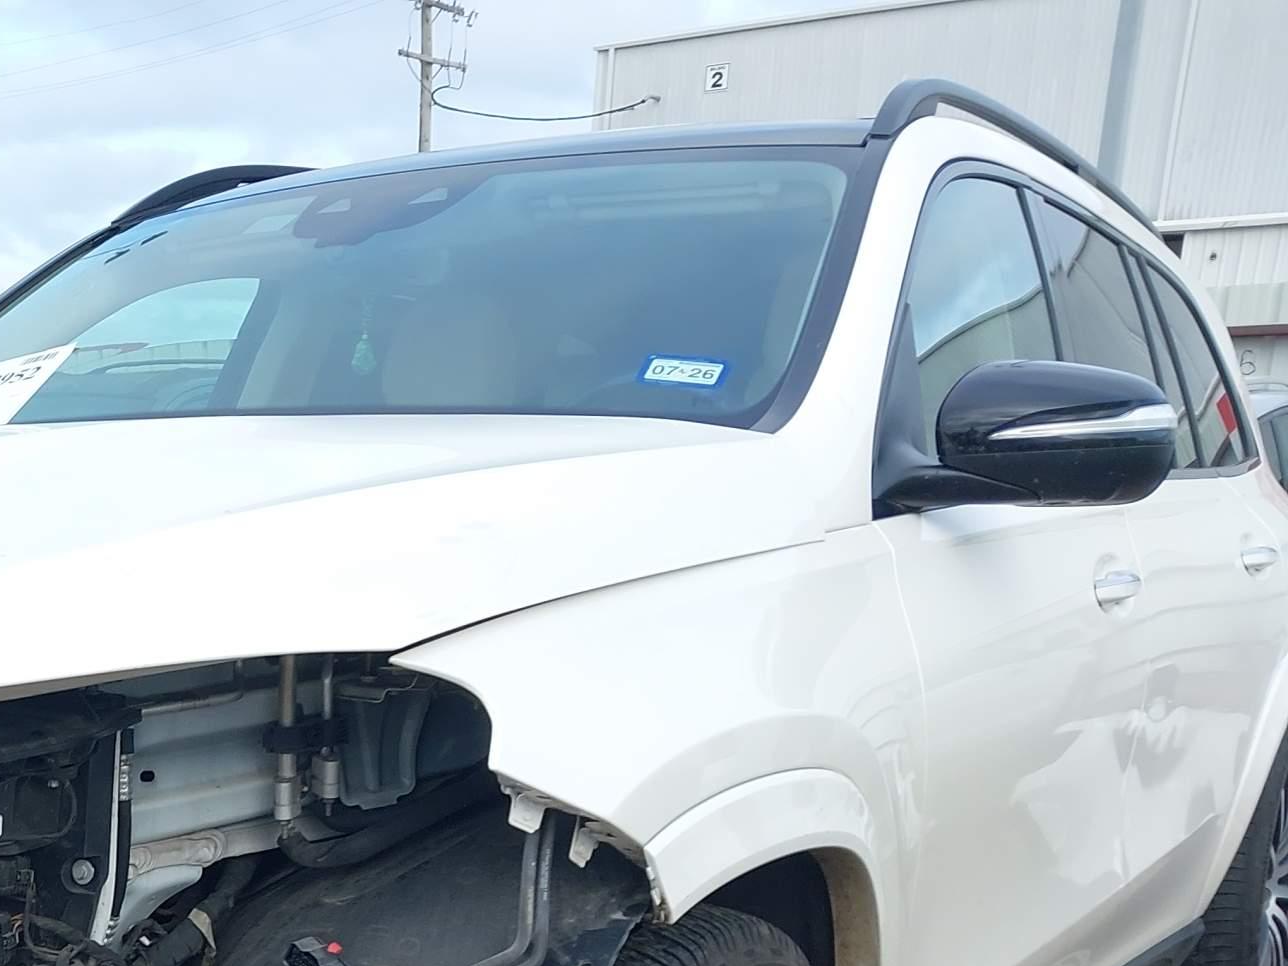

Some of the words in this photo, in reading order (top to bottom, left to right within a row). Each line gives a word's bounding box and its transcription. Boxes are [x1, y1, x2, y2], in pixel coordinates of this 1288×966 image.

[711, 71, 723, 88] 2
[1240, 350, 1256, 375] 6
[652, 364, 680, 376] 07
[688, 367, 716, 380] 26
